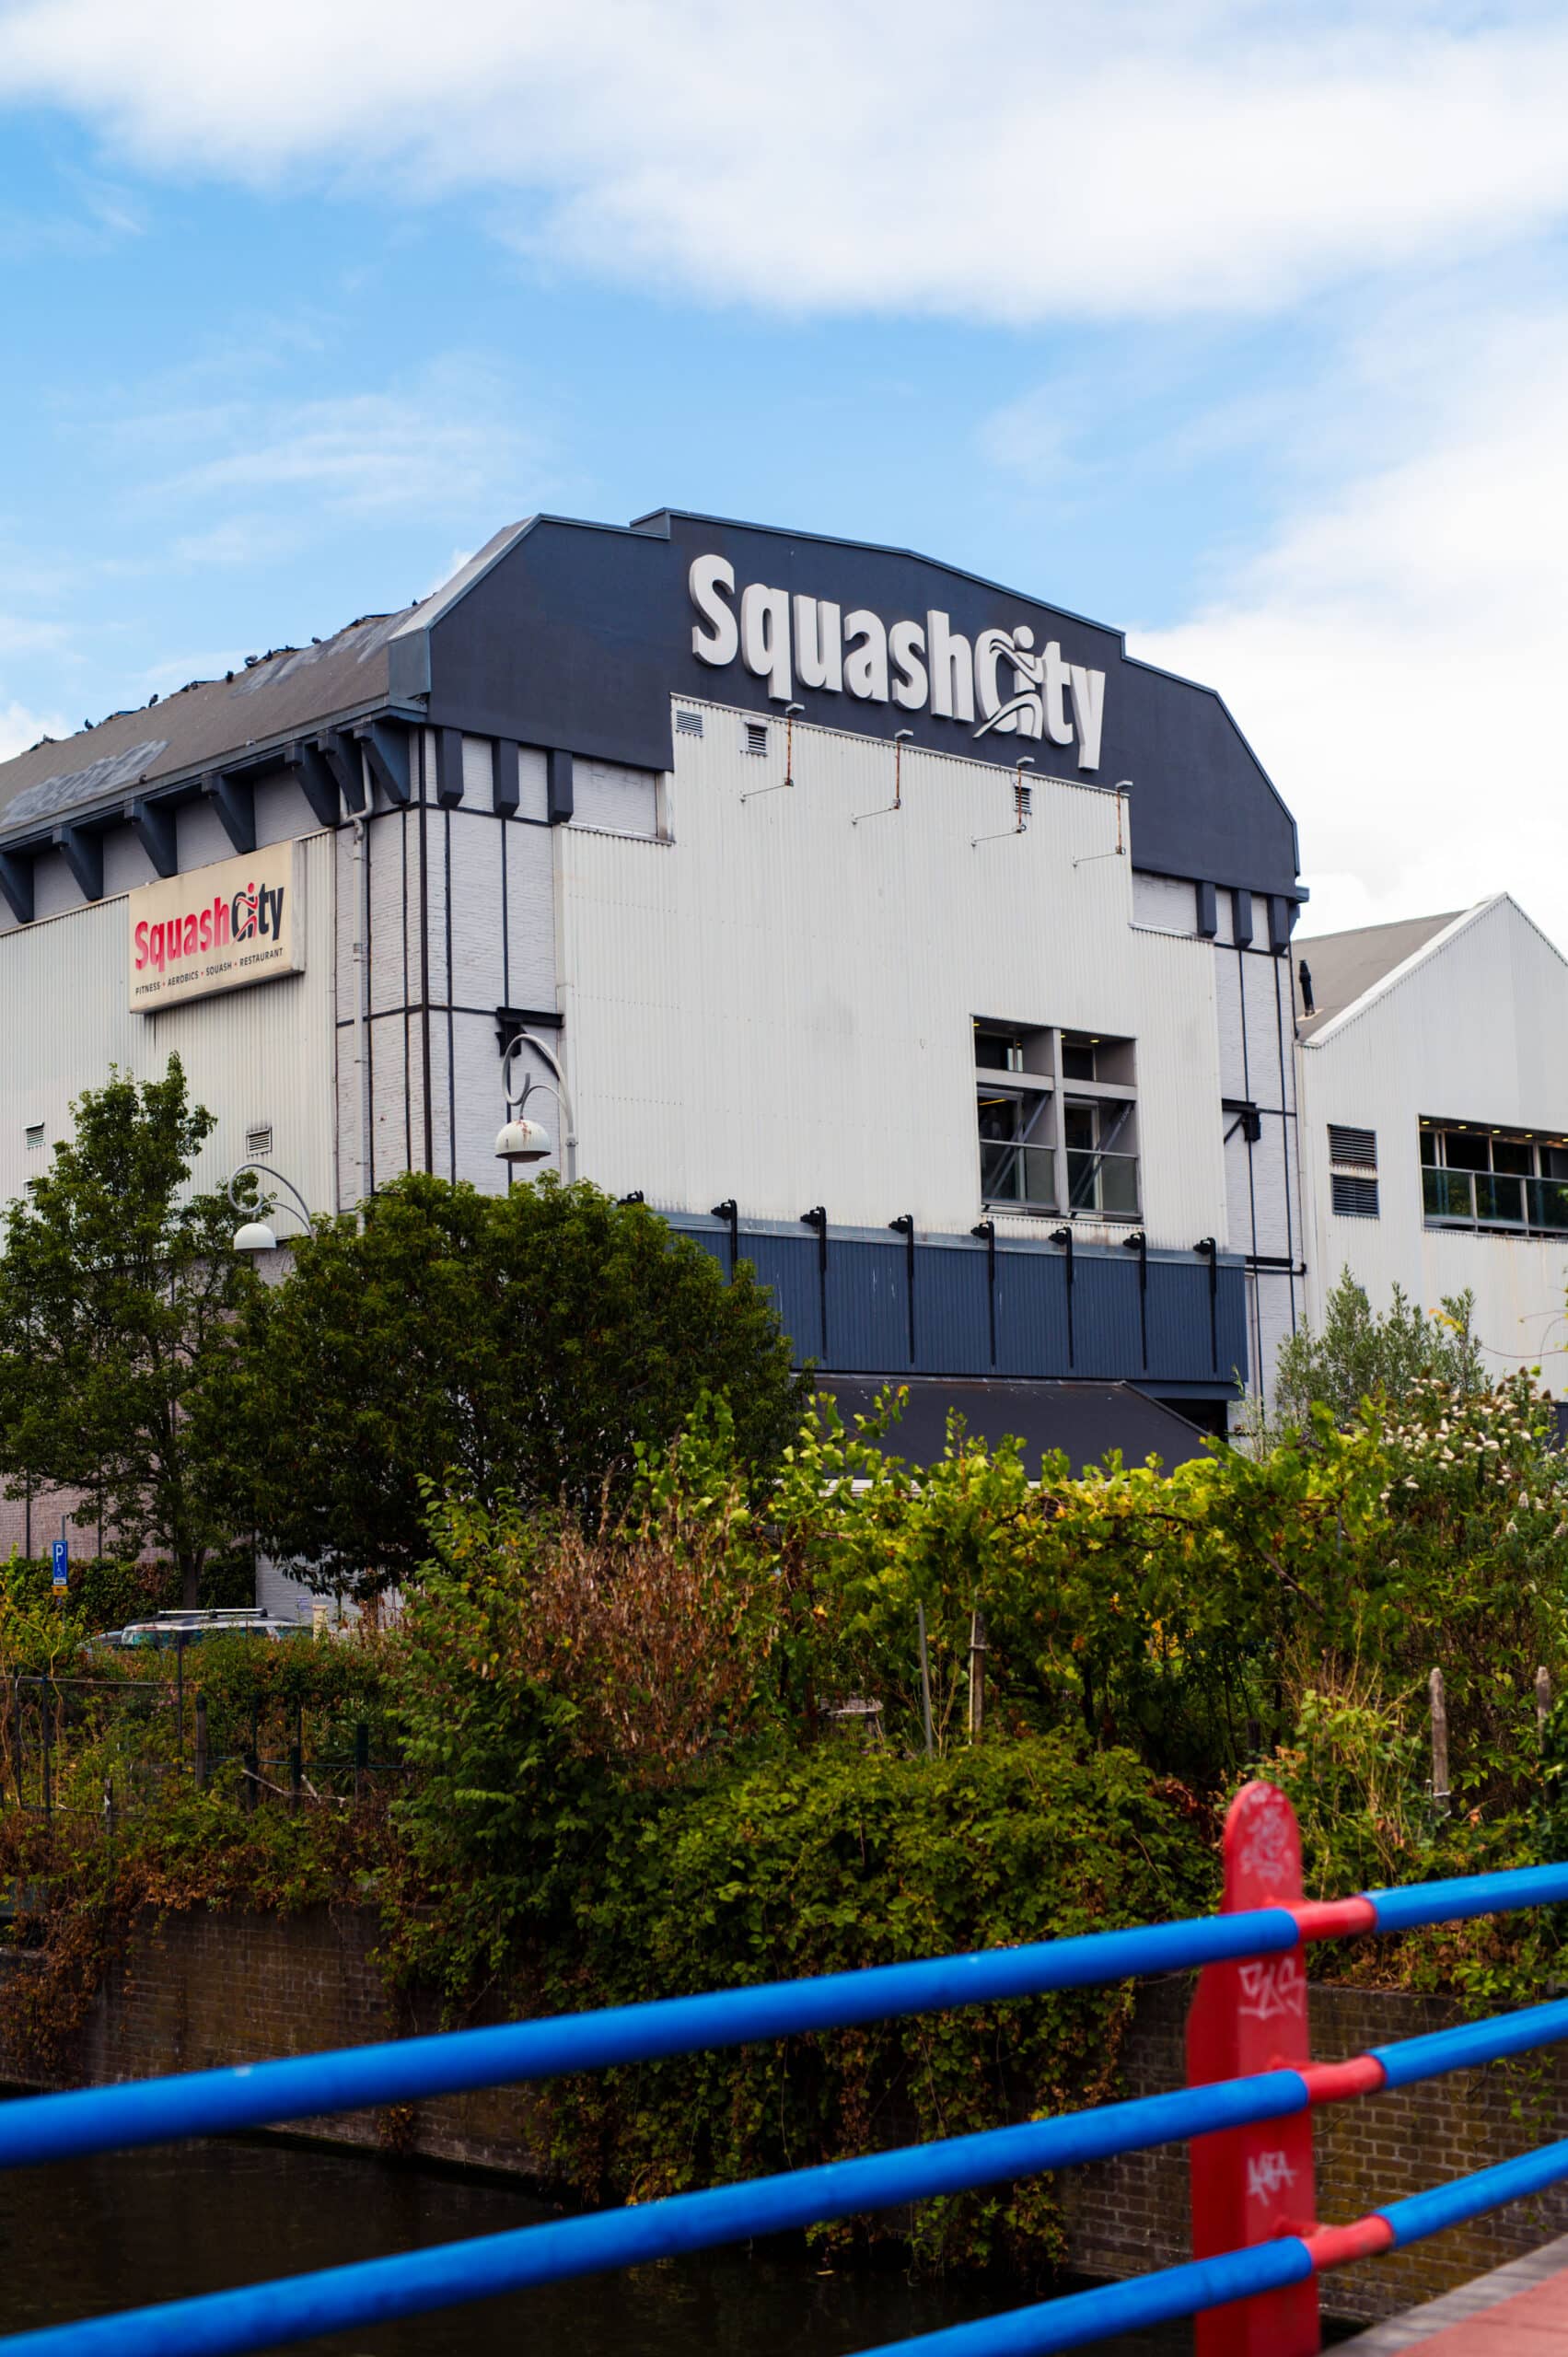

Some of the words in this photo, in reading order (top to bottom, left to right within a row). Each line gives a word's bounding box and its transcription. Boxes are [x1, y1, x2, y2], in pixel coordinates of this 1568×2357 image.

[135, 981, 161, 995] FITNESS
[168, 970, 199, 986] AEROBICS
[205, 962, 232, 977] SQUASH
[239, 947, 284, 967] RESTAURANT
[56, 1544, 64, 1562] P
